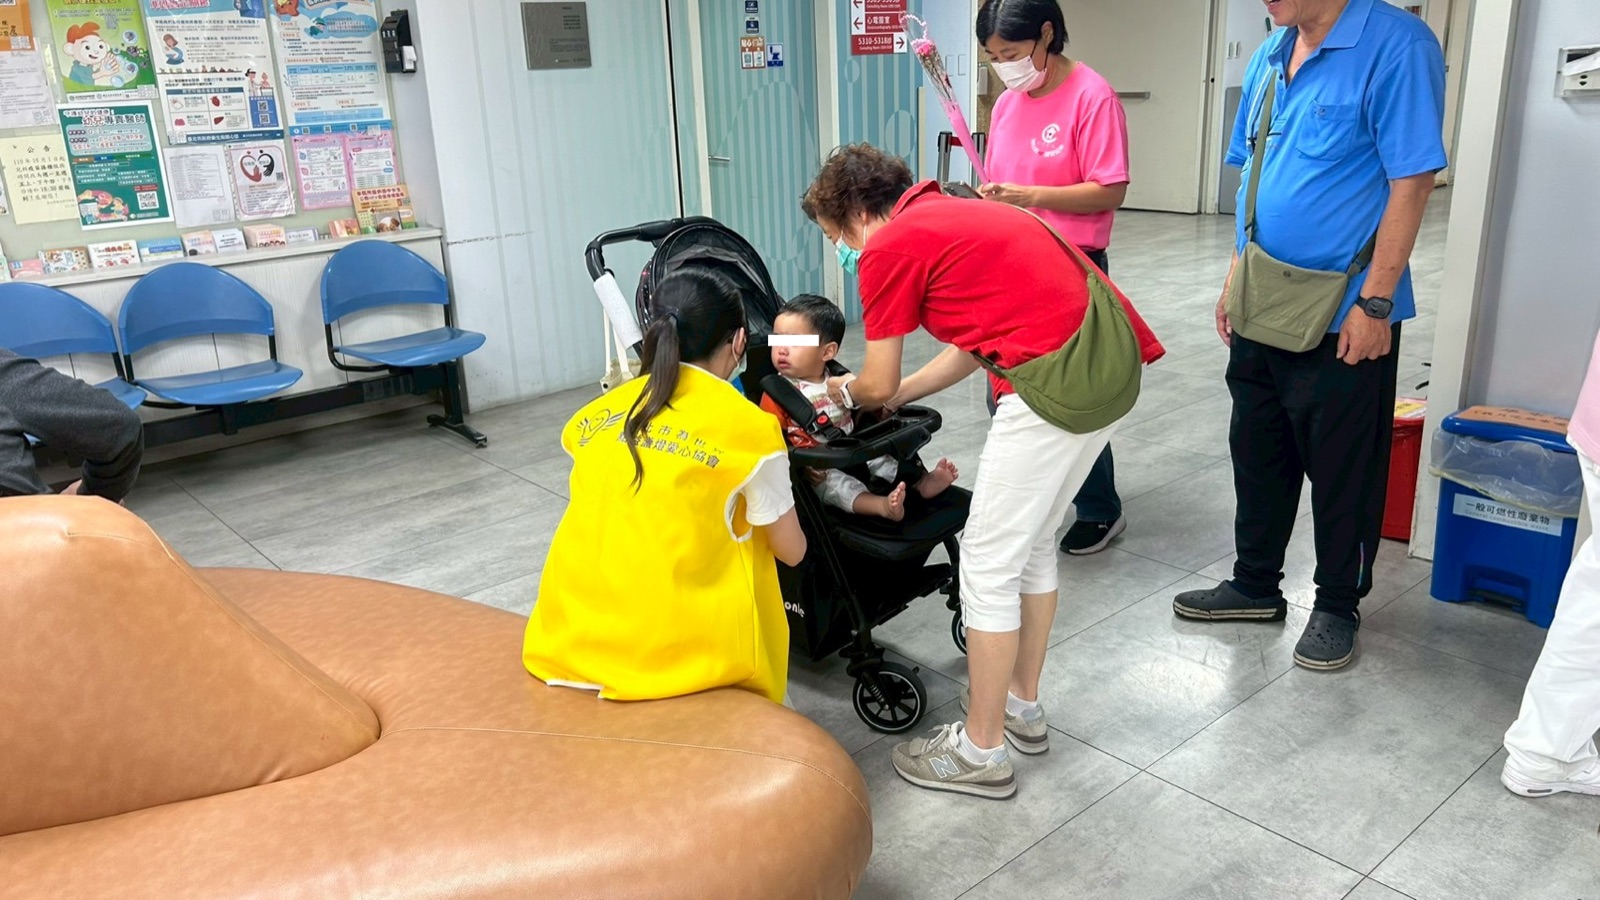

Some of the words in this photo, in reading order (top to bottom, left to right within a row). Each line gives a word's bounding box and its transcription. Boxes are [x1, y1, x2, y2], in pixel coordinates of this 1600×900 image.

[1465, 501, 1550, 526] 一般可燃性廢棄物
[929, 754, 960, 778] N
